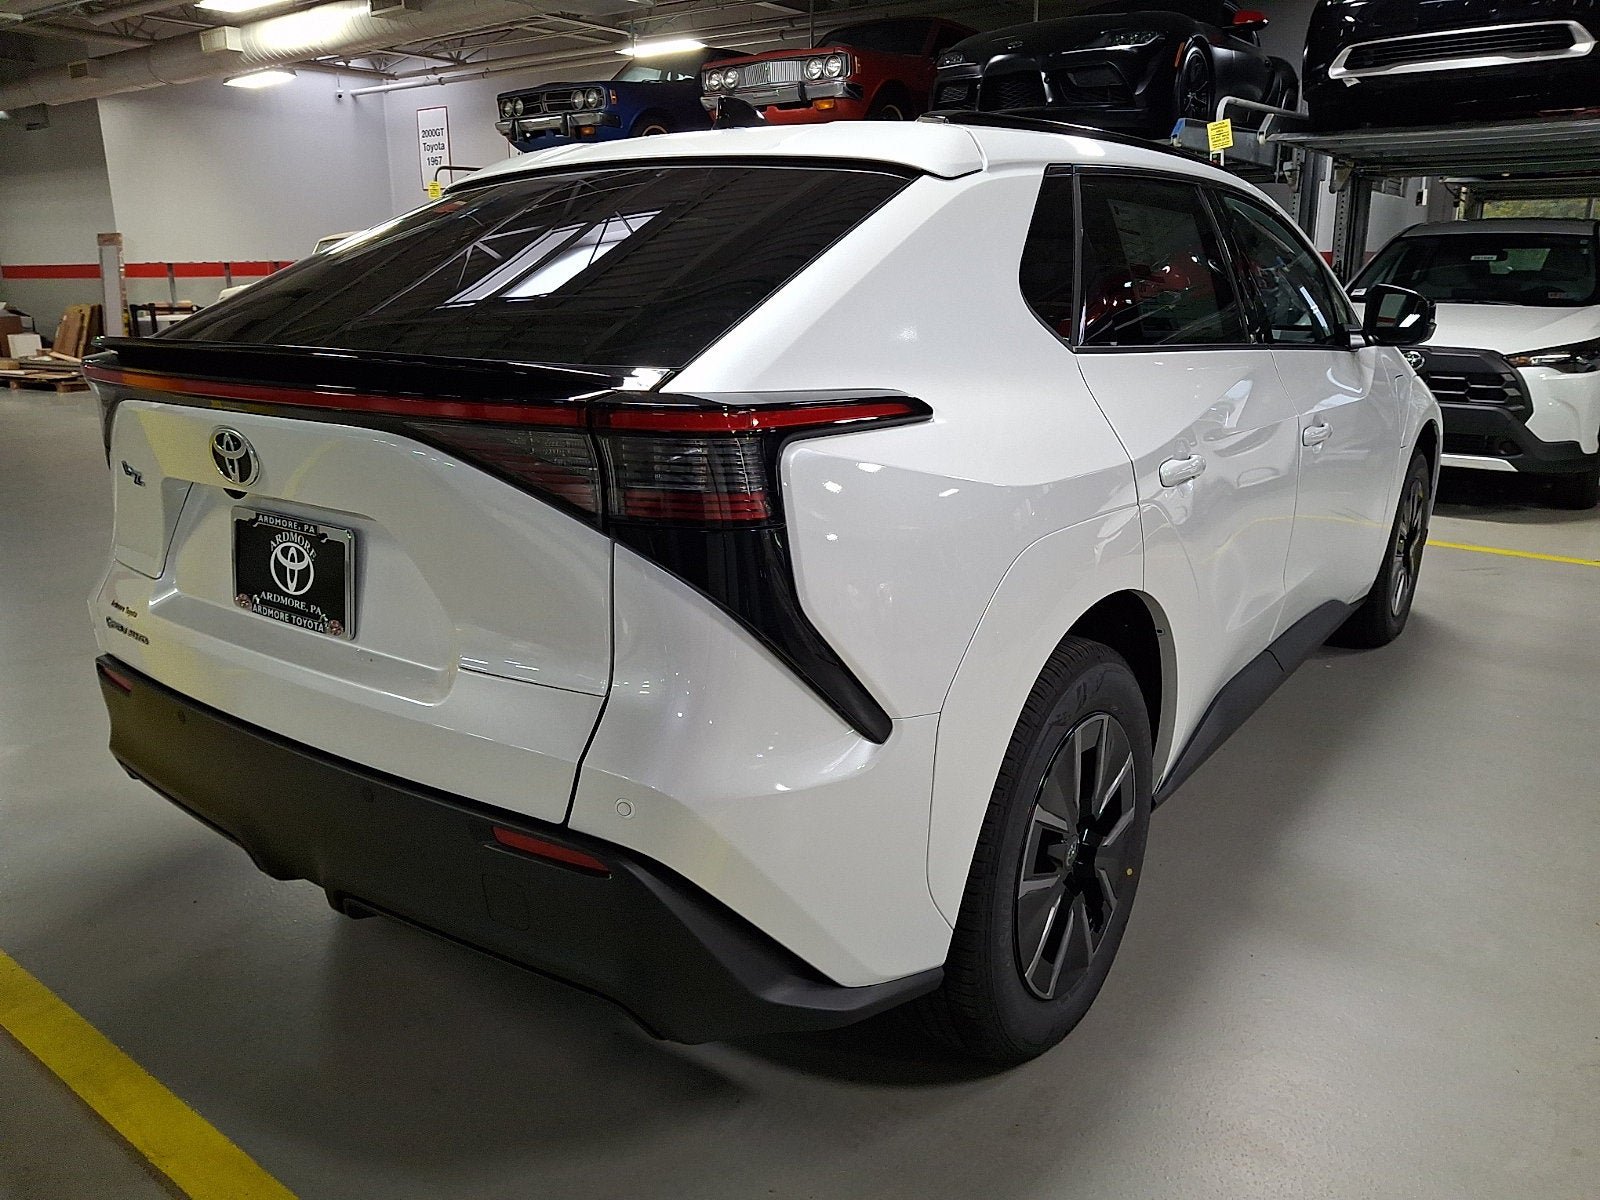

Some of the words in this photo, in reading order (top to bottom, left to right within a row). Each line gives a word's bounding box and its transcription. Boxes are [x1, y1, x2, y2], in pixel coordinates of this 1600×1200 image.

[421, 127, 445, 139] 2000GT
[422, 142, 446, 153] Toyota
[426, 156, 443, 166] 1967
[258, 514, 301, 531] ARDMORE,
[303, 523, 316, 534] PA
[269, 531, 318, 562] ARDMORE
[260, 590, 309, 613] ARDMORE,
[310, 604, 322, 616] PA
[252, 603, 290, 623] ARDMORE
[290, 614, 325, 633] TOYOTA
